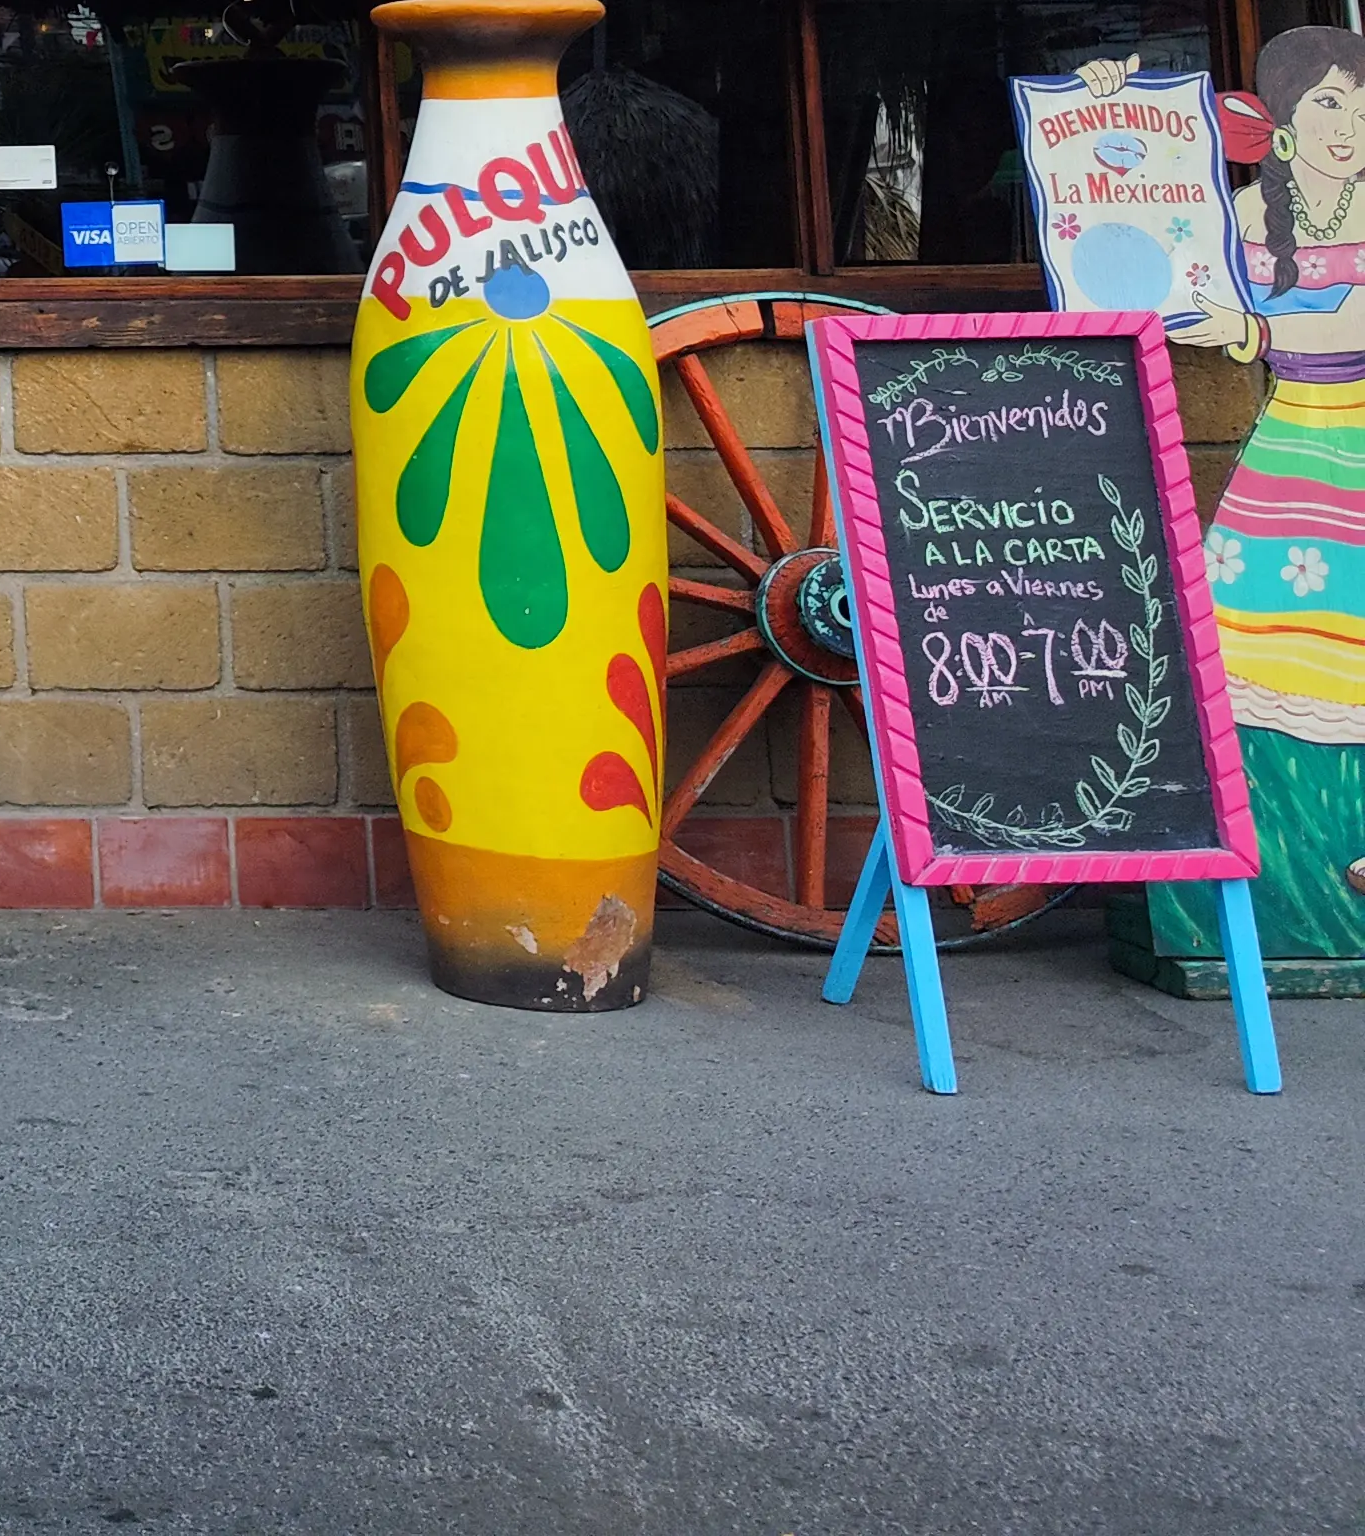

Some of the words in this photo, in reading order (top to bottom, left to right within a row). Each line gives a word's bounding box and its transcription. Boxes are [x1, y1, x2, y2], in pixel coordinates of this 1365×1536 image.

[1037, 102, 1198, 149] BIENVENIDOS
[1049, 172, 1084, 204] La
[1088, 172, 1207, 204] Mexicana
[69, 230, 112, 245] VISA
[116, 221, 159, 235] OPEN
[117, 235, 159, 244] ABIERTO
[429, 265, 469, 308] DE
[476, 217, 599, 282] JALISCO
[877, 389, 1108, 465] Bienvenidos
[925, 541, 946, 565] A
[952, 539, 993, 565] LA
[1003, 535, 1105, 565] CARTA
[908, 573, 976, 600] Lunes
[986, 579, 1003, 596] a
[923, 602, 949, 622] de
[979, 690, 1012, 707] AM
[1078, 681, 1114, 700] PM
